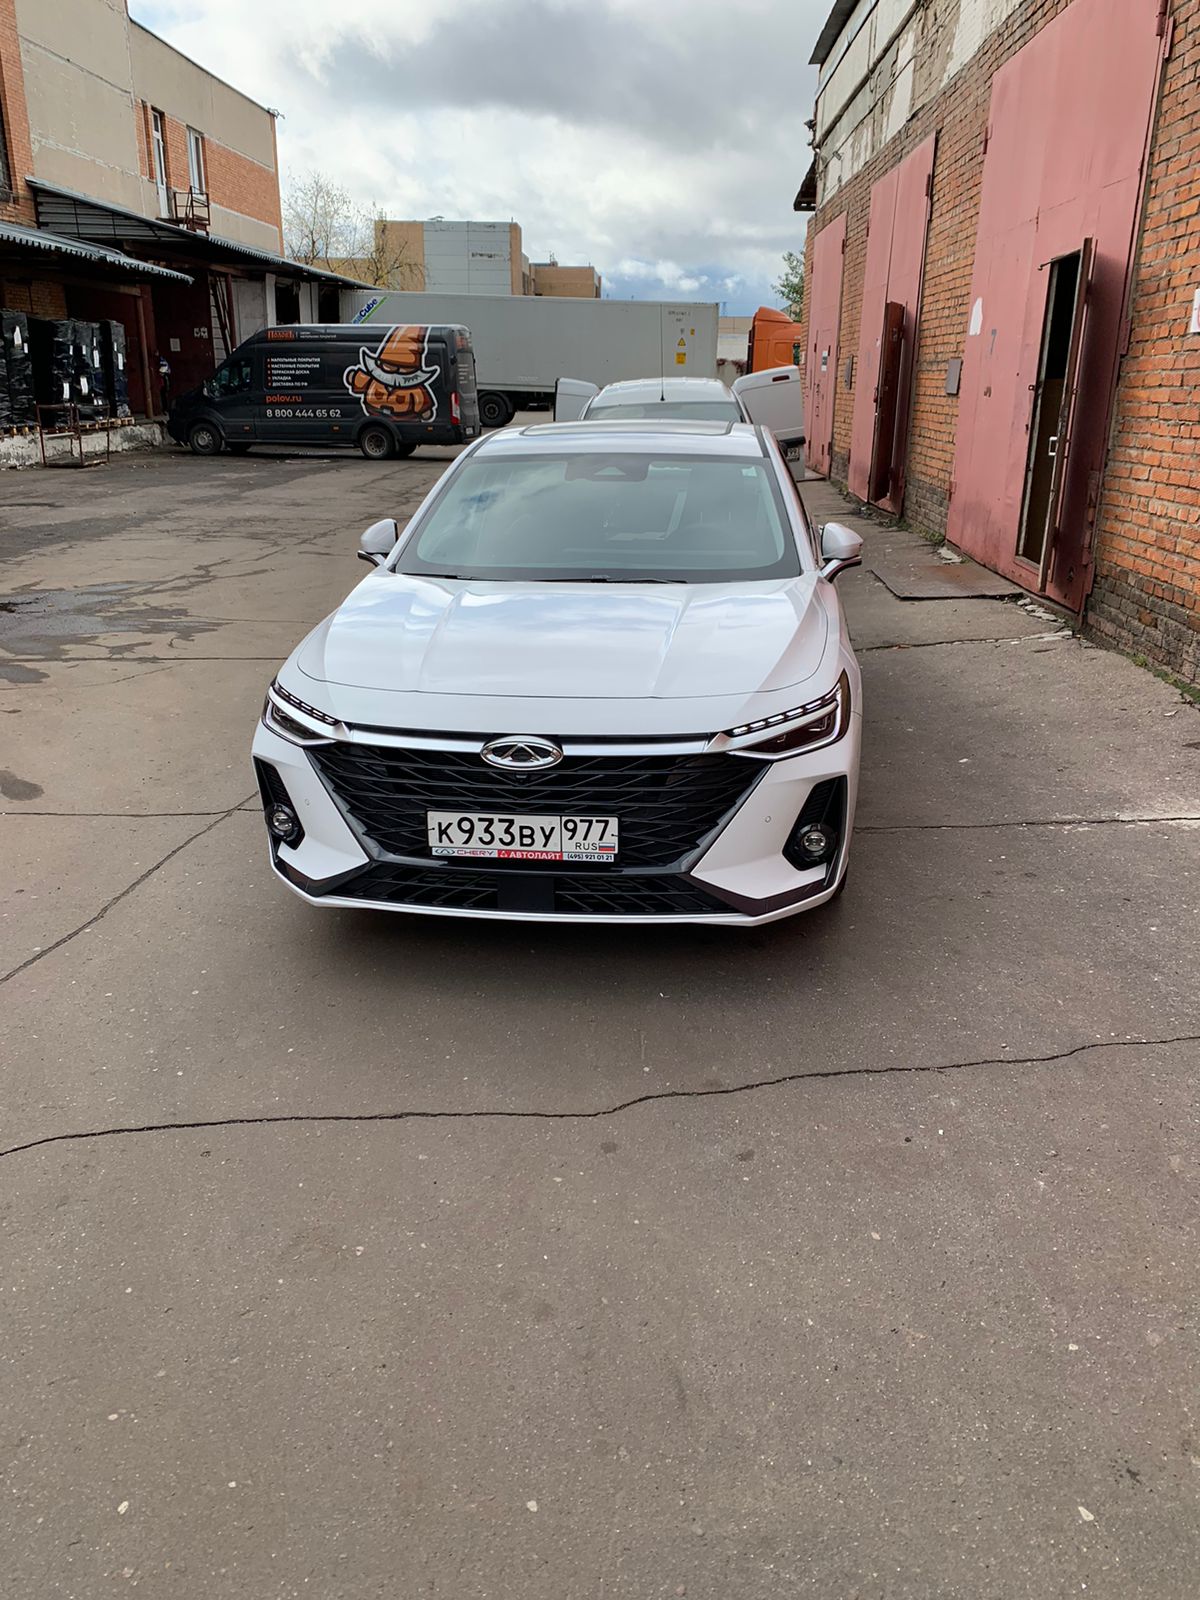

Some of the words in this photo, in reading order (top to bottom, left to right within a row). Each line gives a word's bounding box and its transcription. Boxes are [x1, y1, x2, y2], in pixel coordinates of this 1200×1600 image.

[266, 394, 302, 403] polov.ru
[266, 409, 272, 417] 8
[275, 409, 293, 417] 800
[563, 818, 610, 841] 977
[574, 842, 598, 851] RUS
[509, 850, 562, 861] АВТОЛАЙТ
[567, 853, 584, 861] (495)
[585, 853, 596, 861] 921
